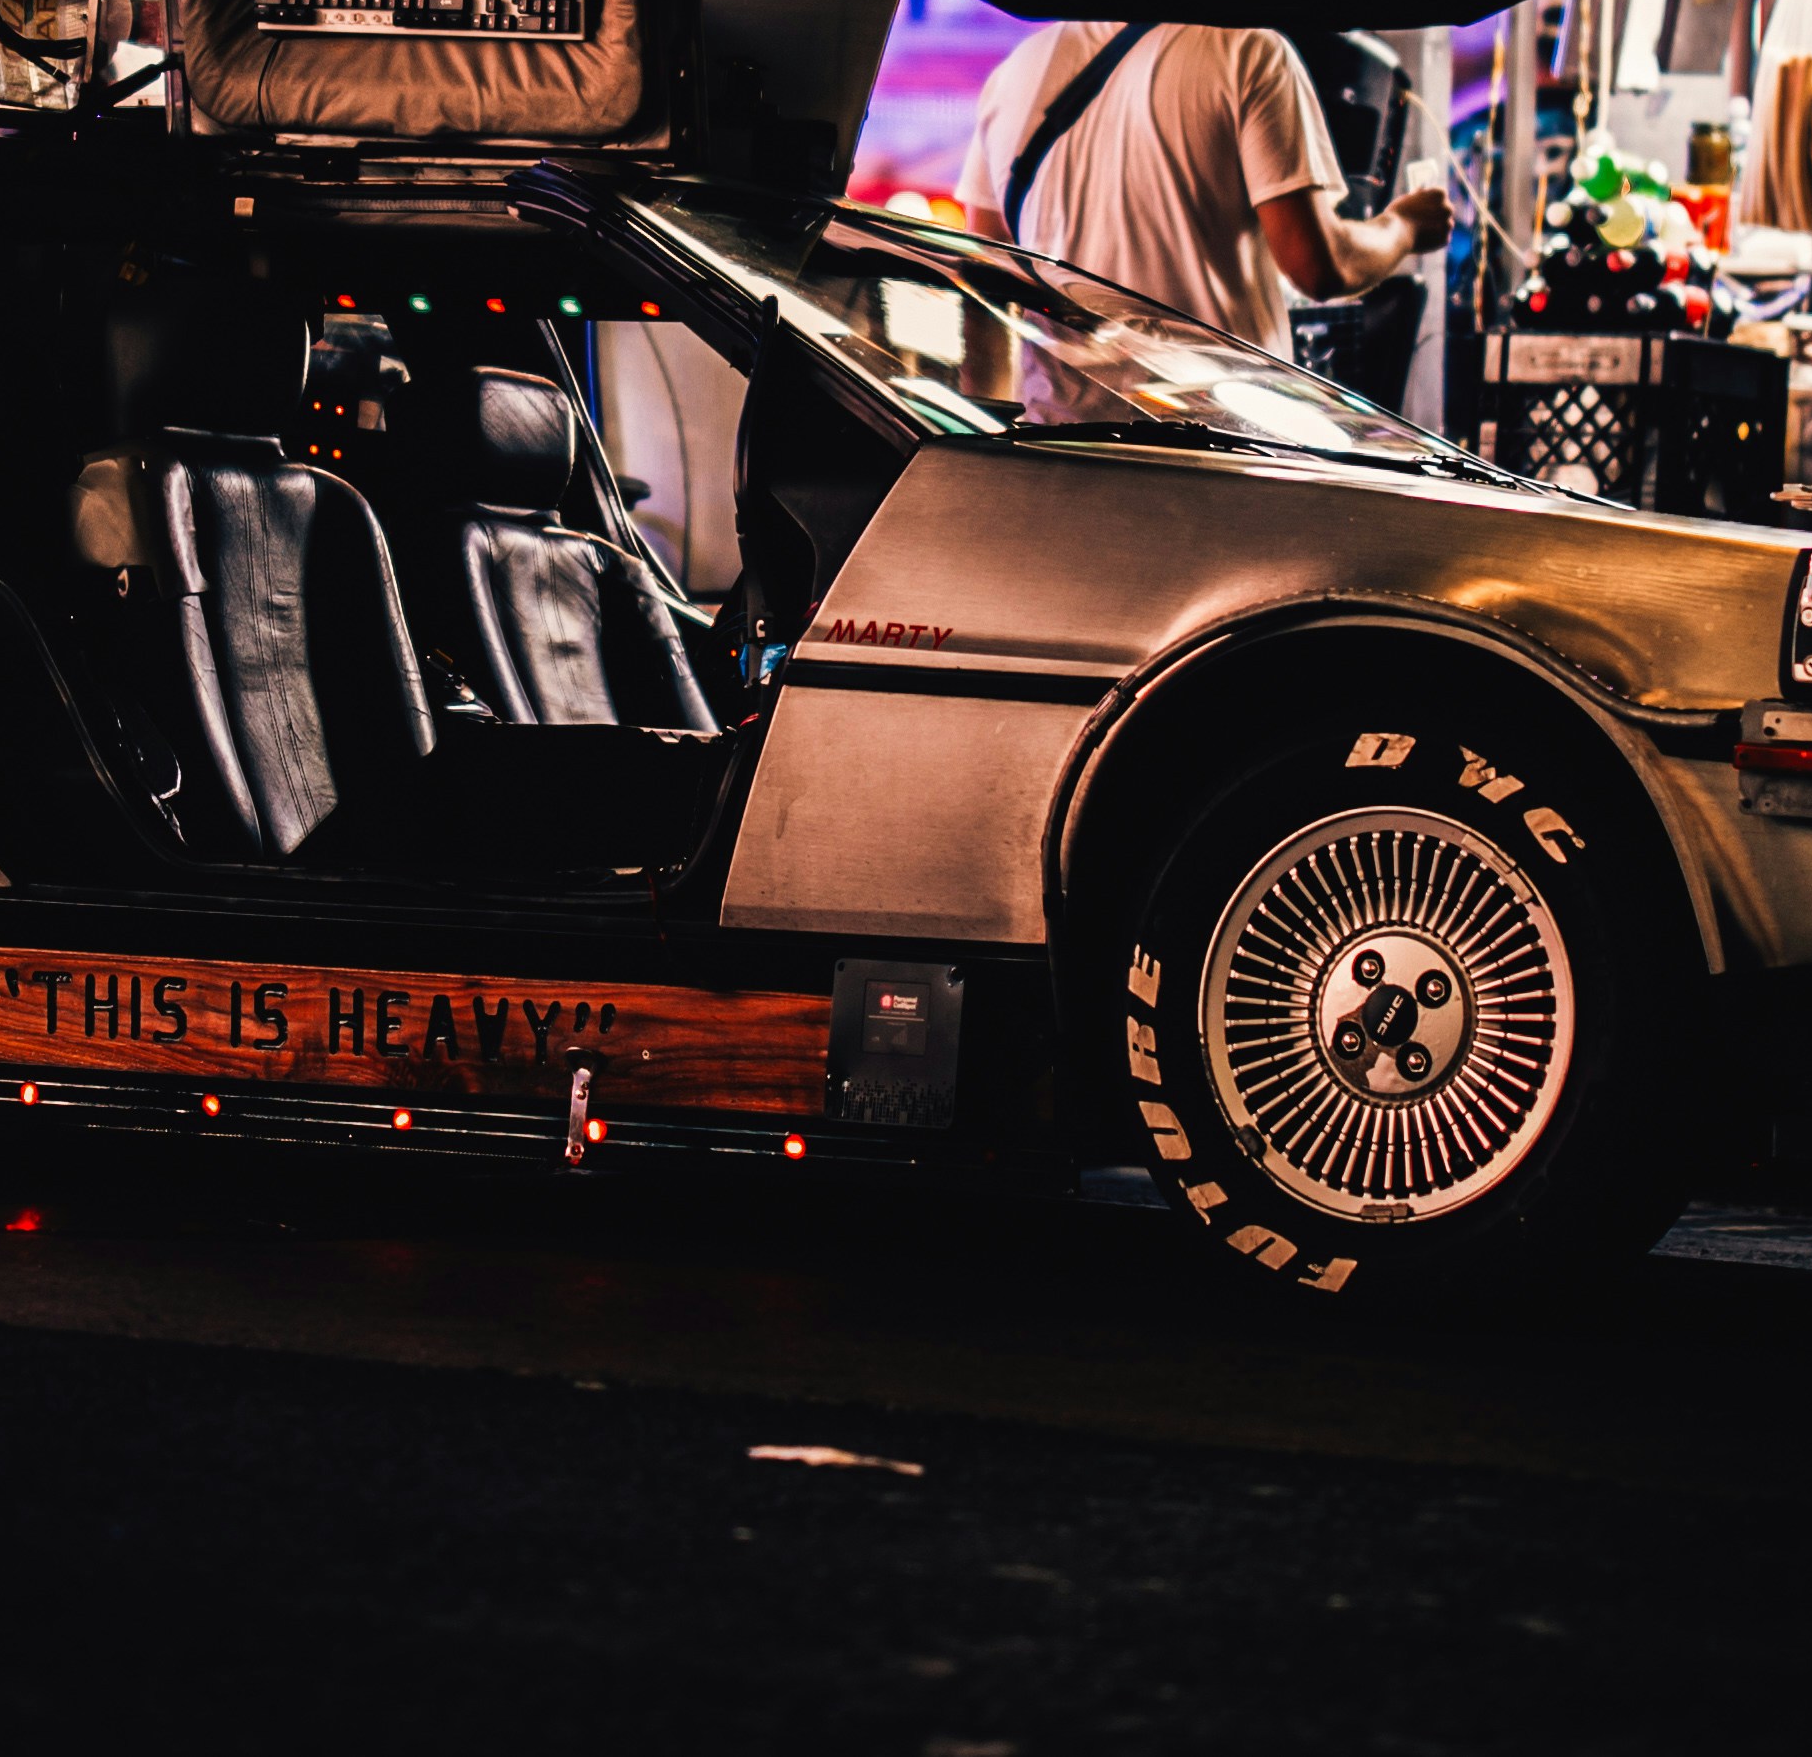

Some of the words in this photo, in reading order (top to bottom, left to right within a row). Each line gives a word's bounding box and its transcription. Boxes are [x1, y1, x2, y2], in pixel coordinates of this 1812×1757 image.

[824, 618, 953, 651] MARTY
[230, 980, 289, 1051] IS
[328, 985, 617, 1066] HEAVY"
[1126, 943, 1359, 1293] FUTURE
